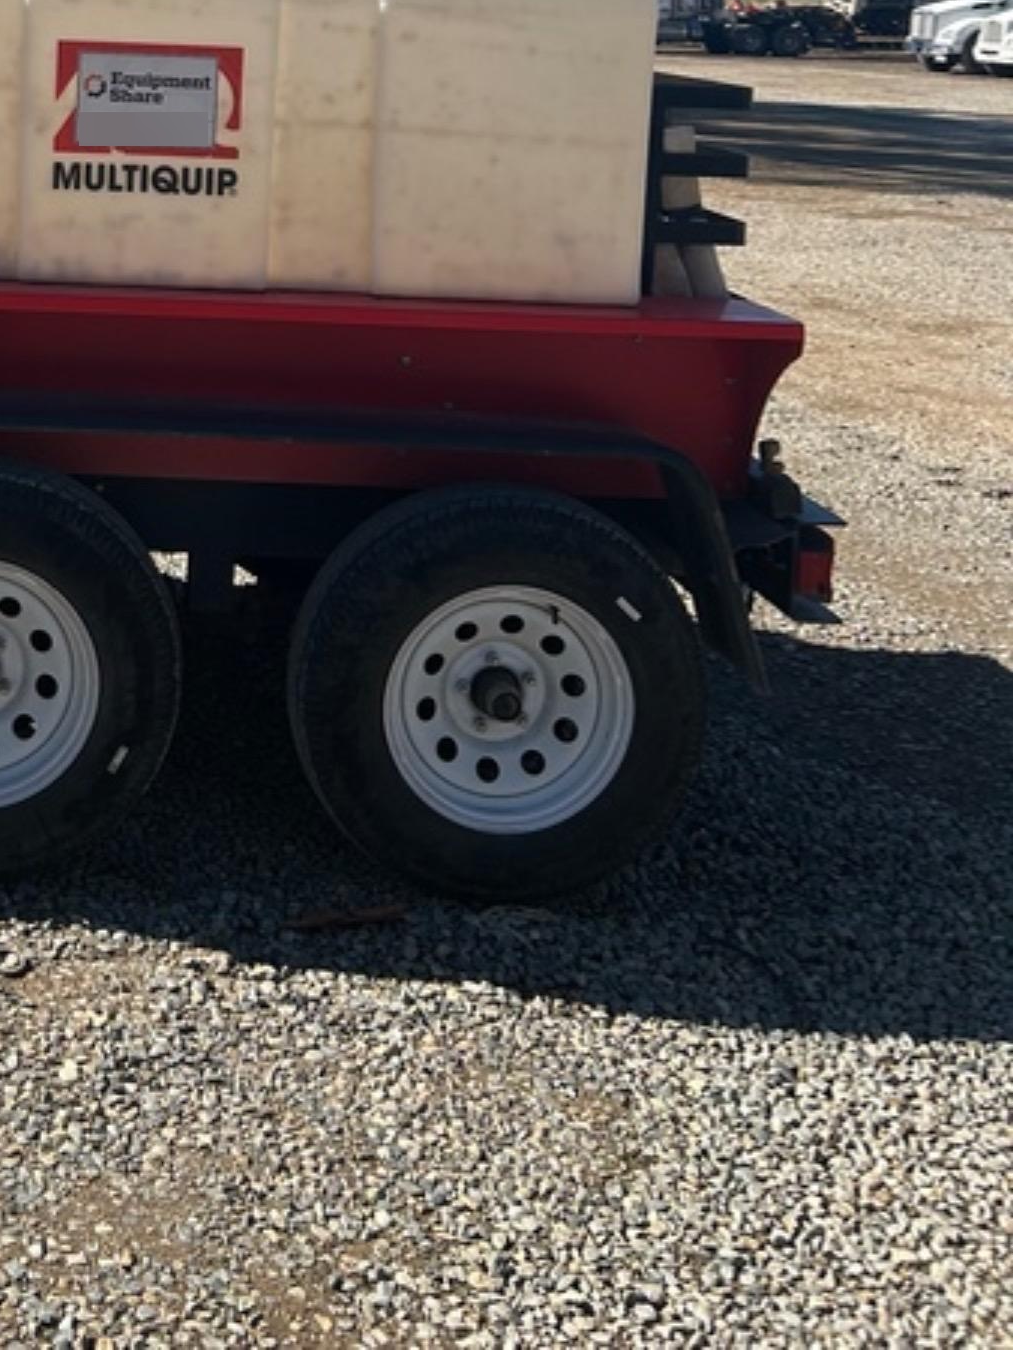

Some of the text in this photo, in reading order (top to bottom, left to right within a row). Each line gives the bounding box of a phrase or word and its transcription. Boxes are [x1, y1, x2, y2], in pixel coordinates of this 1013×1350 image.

[110, 71, 211, 90] Equipment
[109, 88, 164, 105] Share
[51, 161, 238, 197] MULTIQUIP
